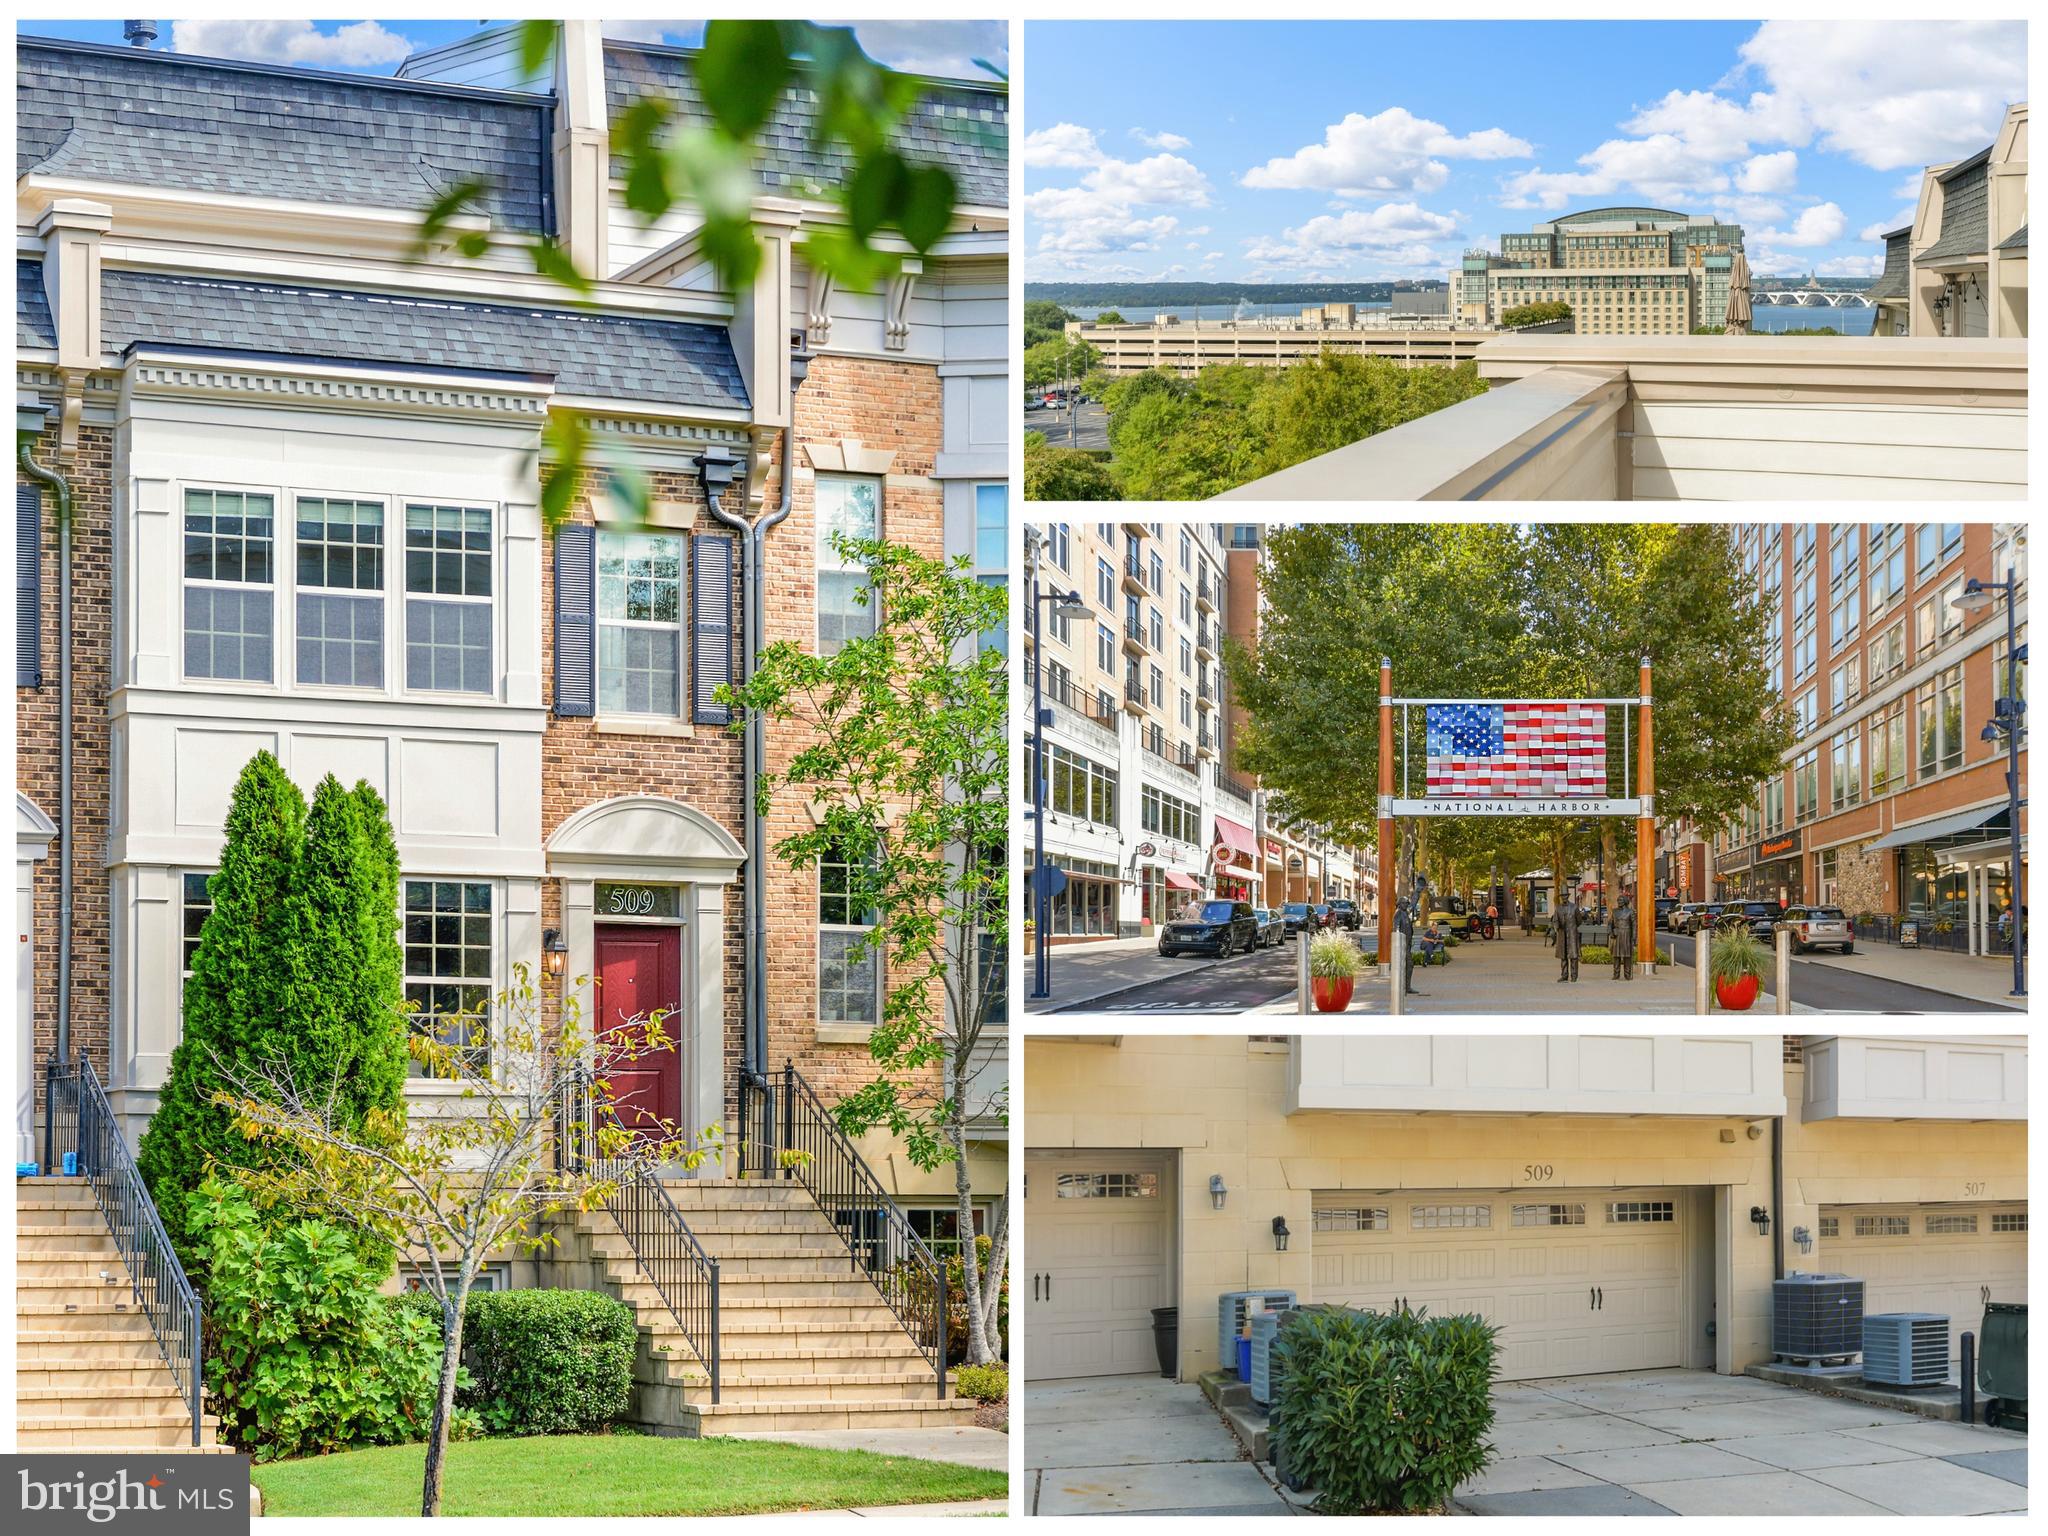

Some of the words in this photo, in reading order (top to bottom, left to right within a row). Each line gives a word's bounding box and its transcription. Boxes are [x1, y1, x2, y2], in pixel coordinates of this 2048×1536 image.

[1433, 803, 1514, 812] NATIONAL
[1538, 803, 1600, 812] HARBOR
[610, 888, 655, 914] 509
[1524, 1164, 1553, 1182] 509
[1964, 1182, 1985, 1197] 507
